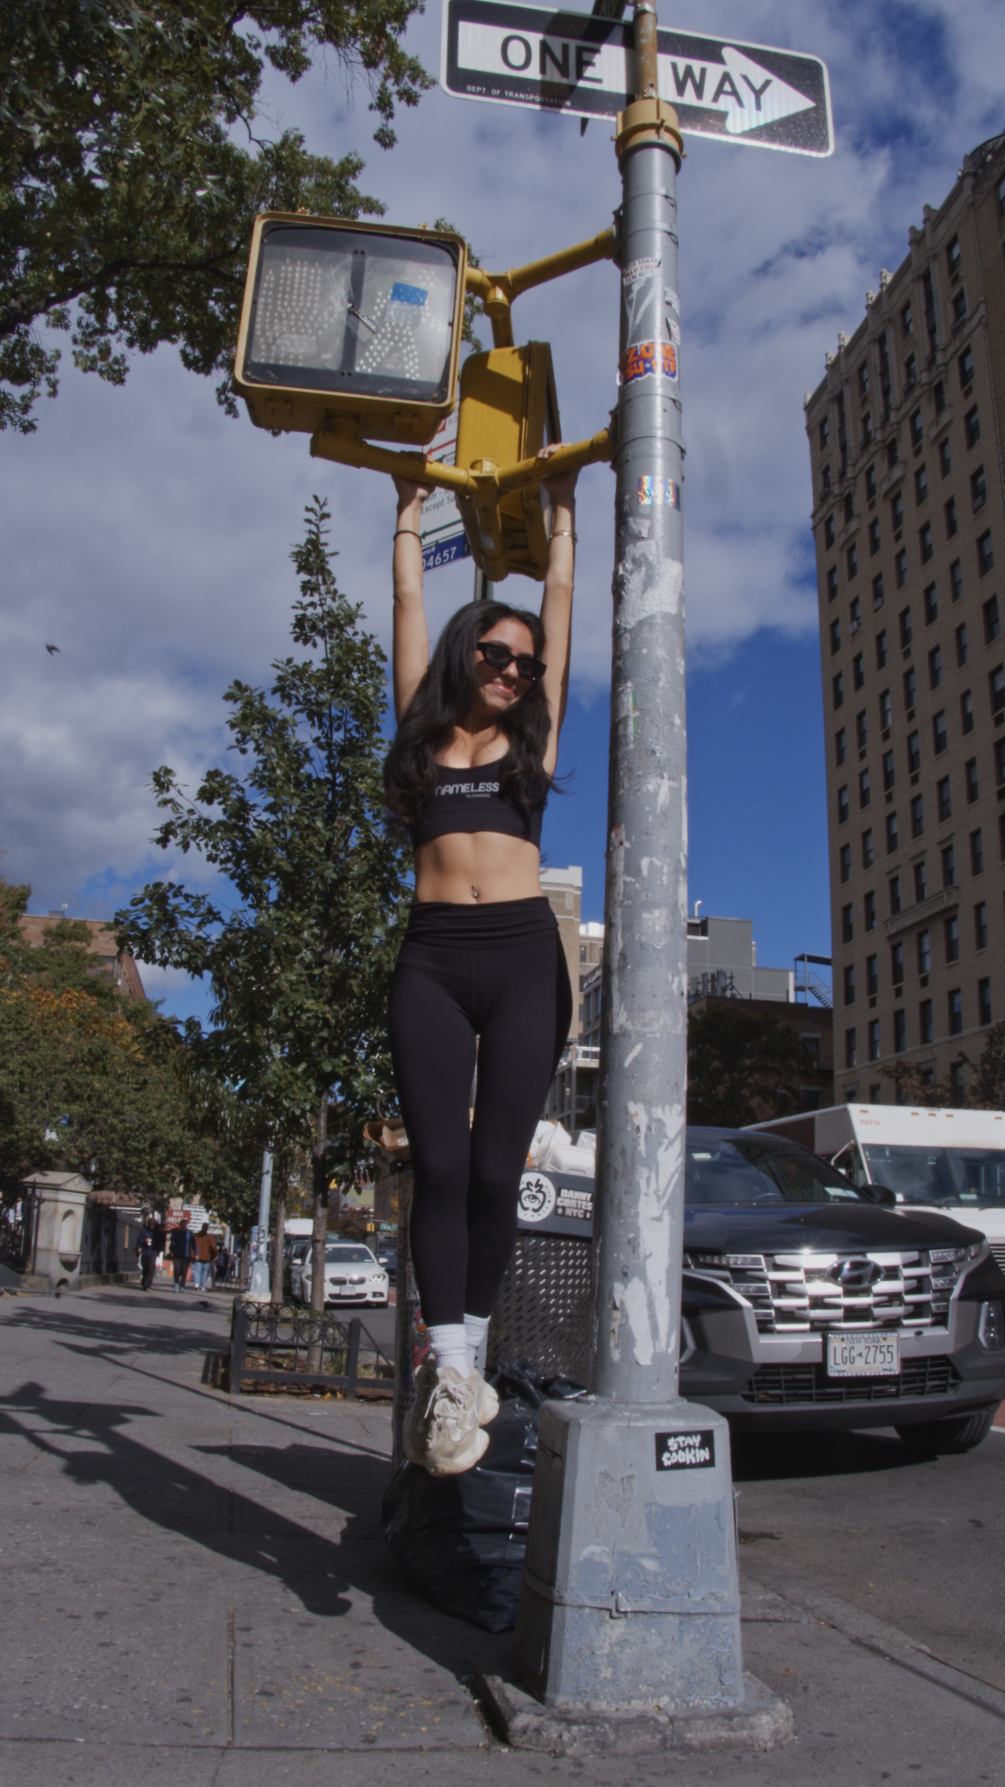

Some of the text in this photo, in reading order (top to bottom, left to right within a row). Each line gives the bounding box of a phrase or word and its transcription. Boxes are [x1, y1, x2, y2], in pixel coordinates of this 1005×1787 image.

[501, 34, 773, 112] ONE WAY
[491, 88, 501, 96] OF
[504, 90, 571, 107] TRANSPORTATION
[421, 498, 444, 514] Except
[435, 781, 500, 796] NAMELESS
[560, 1188, 592, 1201] DANNY
[556, 1197, 593, 1211] CORTES
[565, 1207, 585, 1218] NYC
[846, 1336, 882, 1345] NEW YORK
[833, 1344, 894, 1366] LGG 2755
[662, 1447, 710, 1467] COOKIN
